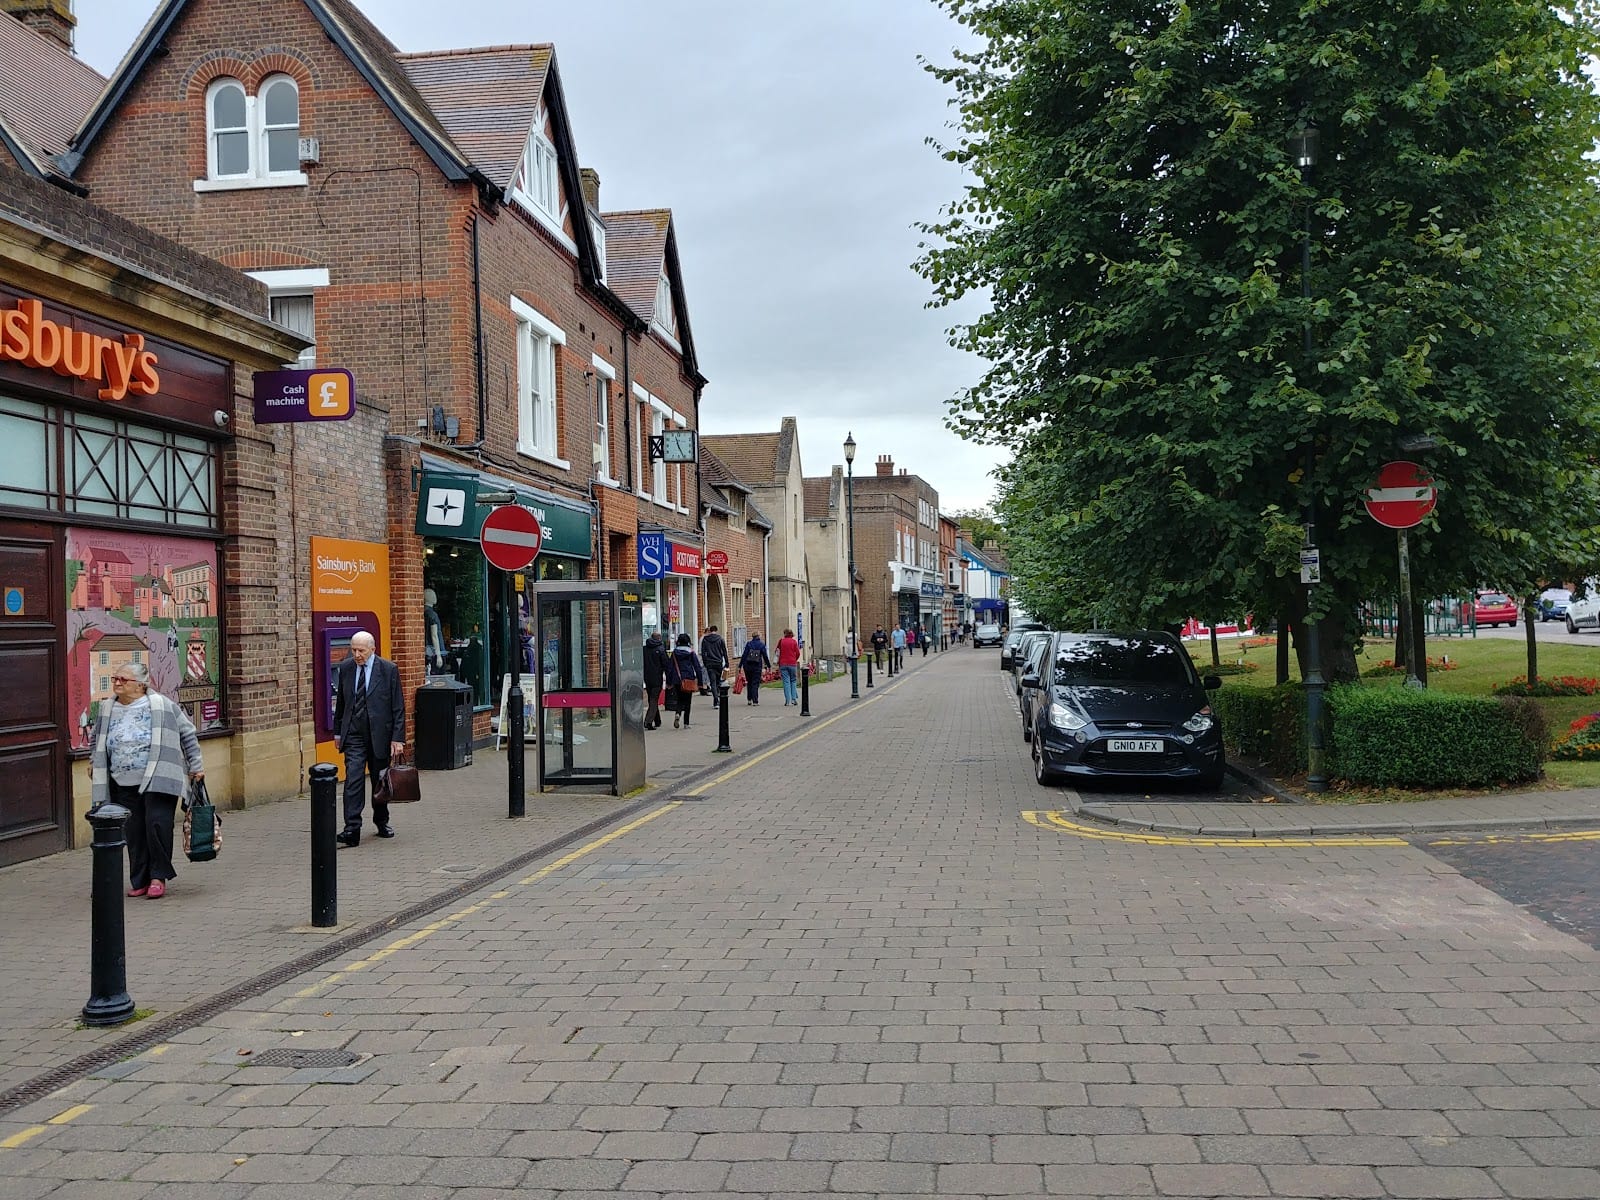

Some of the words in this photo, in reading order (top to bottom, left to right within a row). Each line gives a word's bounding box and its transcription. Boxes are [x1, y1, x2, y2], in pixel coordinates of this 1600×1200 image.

[0, 298, 160, 401] sbury's
[282, 384, 305, 394] Cash
[265, 396, 305, 406] machine
[641, 537, 660, 546] WH
[316, 555, 358, 574] Sainsbury's
[359, 559, 377, 573] Bank
[641, 546, 662, 576] S
[676, 551, 687, 567] POST
[686, 553, 700, 569] OFFICE
[1113, 741, 1136, 751] GN10
[1138, 741, 1158, 751] AFX
